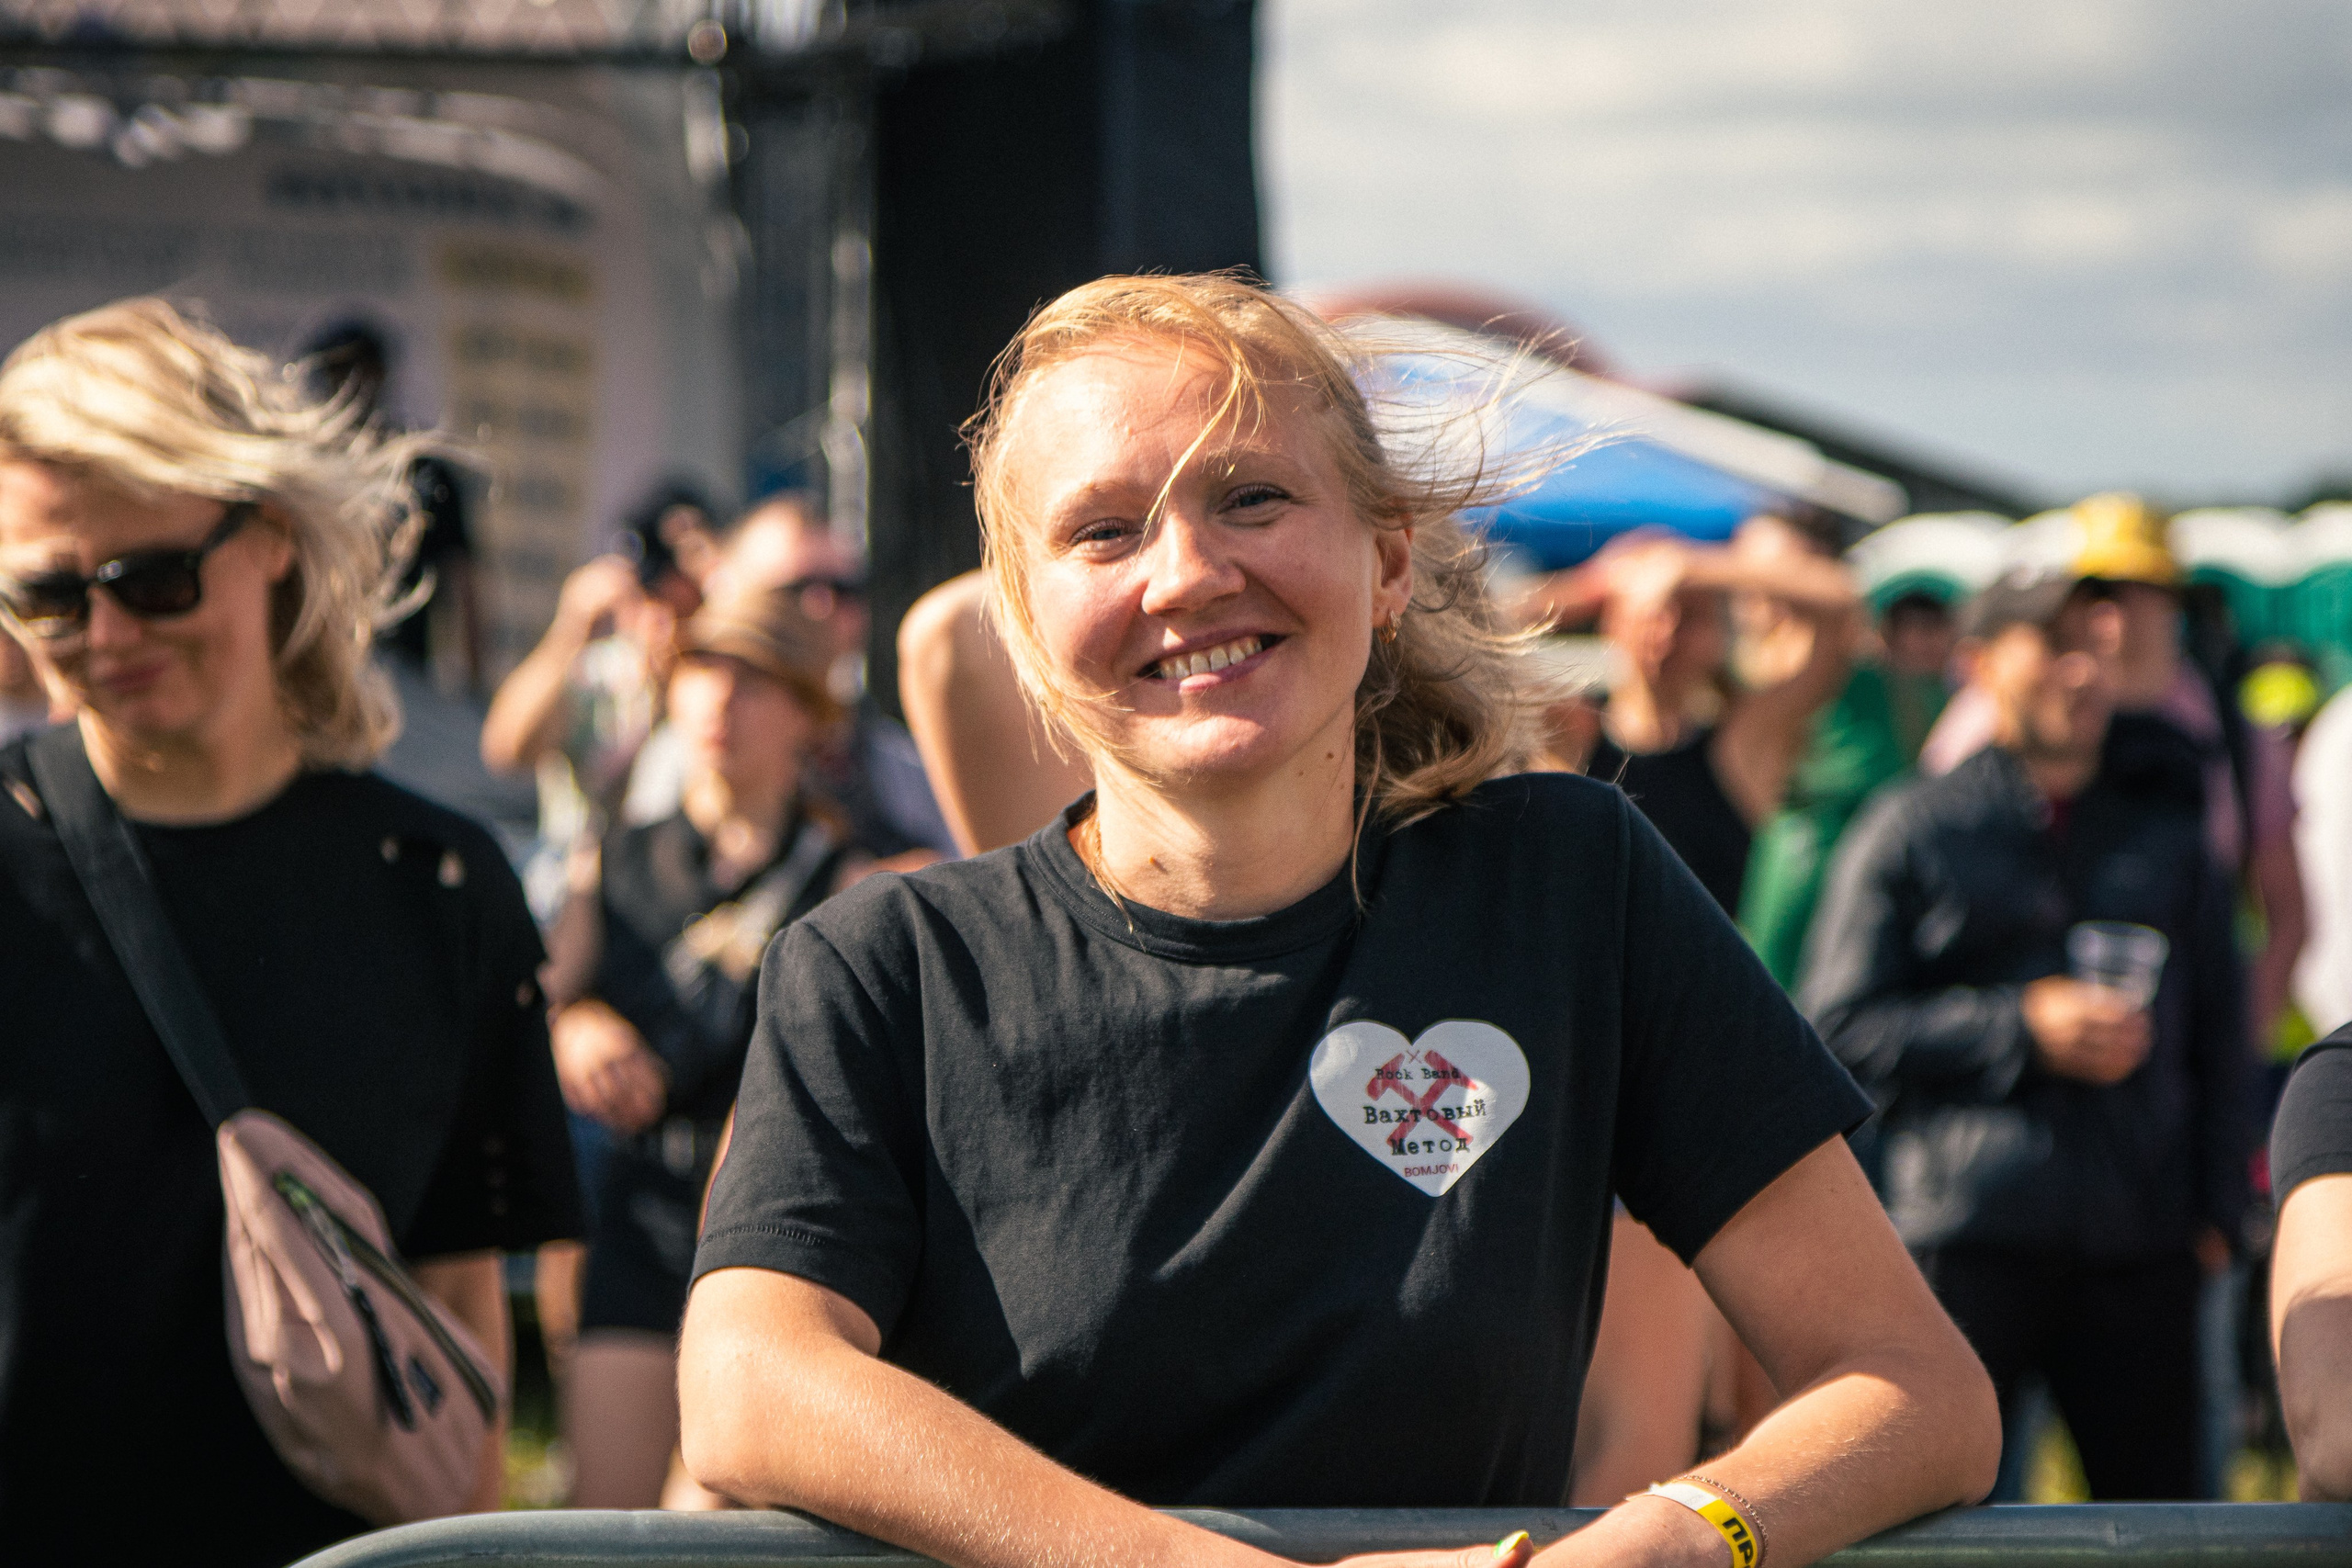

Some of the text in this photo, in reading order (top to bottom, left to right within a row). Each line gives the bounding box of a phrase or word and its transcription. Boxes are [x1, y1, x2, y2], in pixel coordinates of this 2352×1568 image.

[1374, 1066, 1461, 1080] Rock Band
[1363, 1099, 1487, 1124] Вахтовый
[1390, 1137, 1470, 1156] Метод
[1404, 1163, 1459, 1177] BOMJOVI
[1722, 1517, 1754, 1568] ПР
